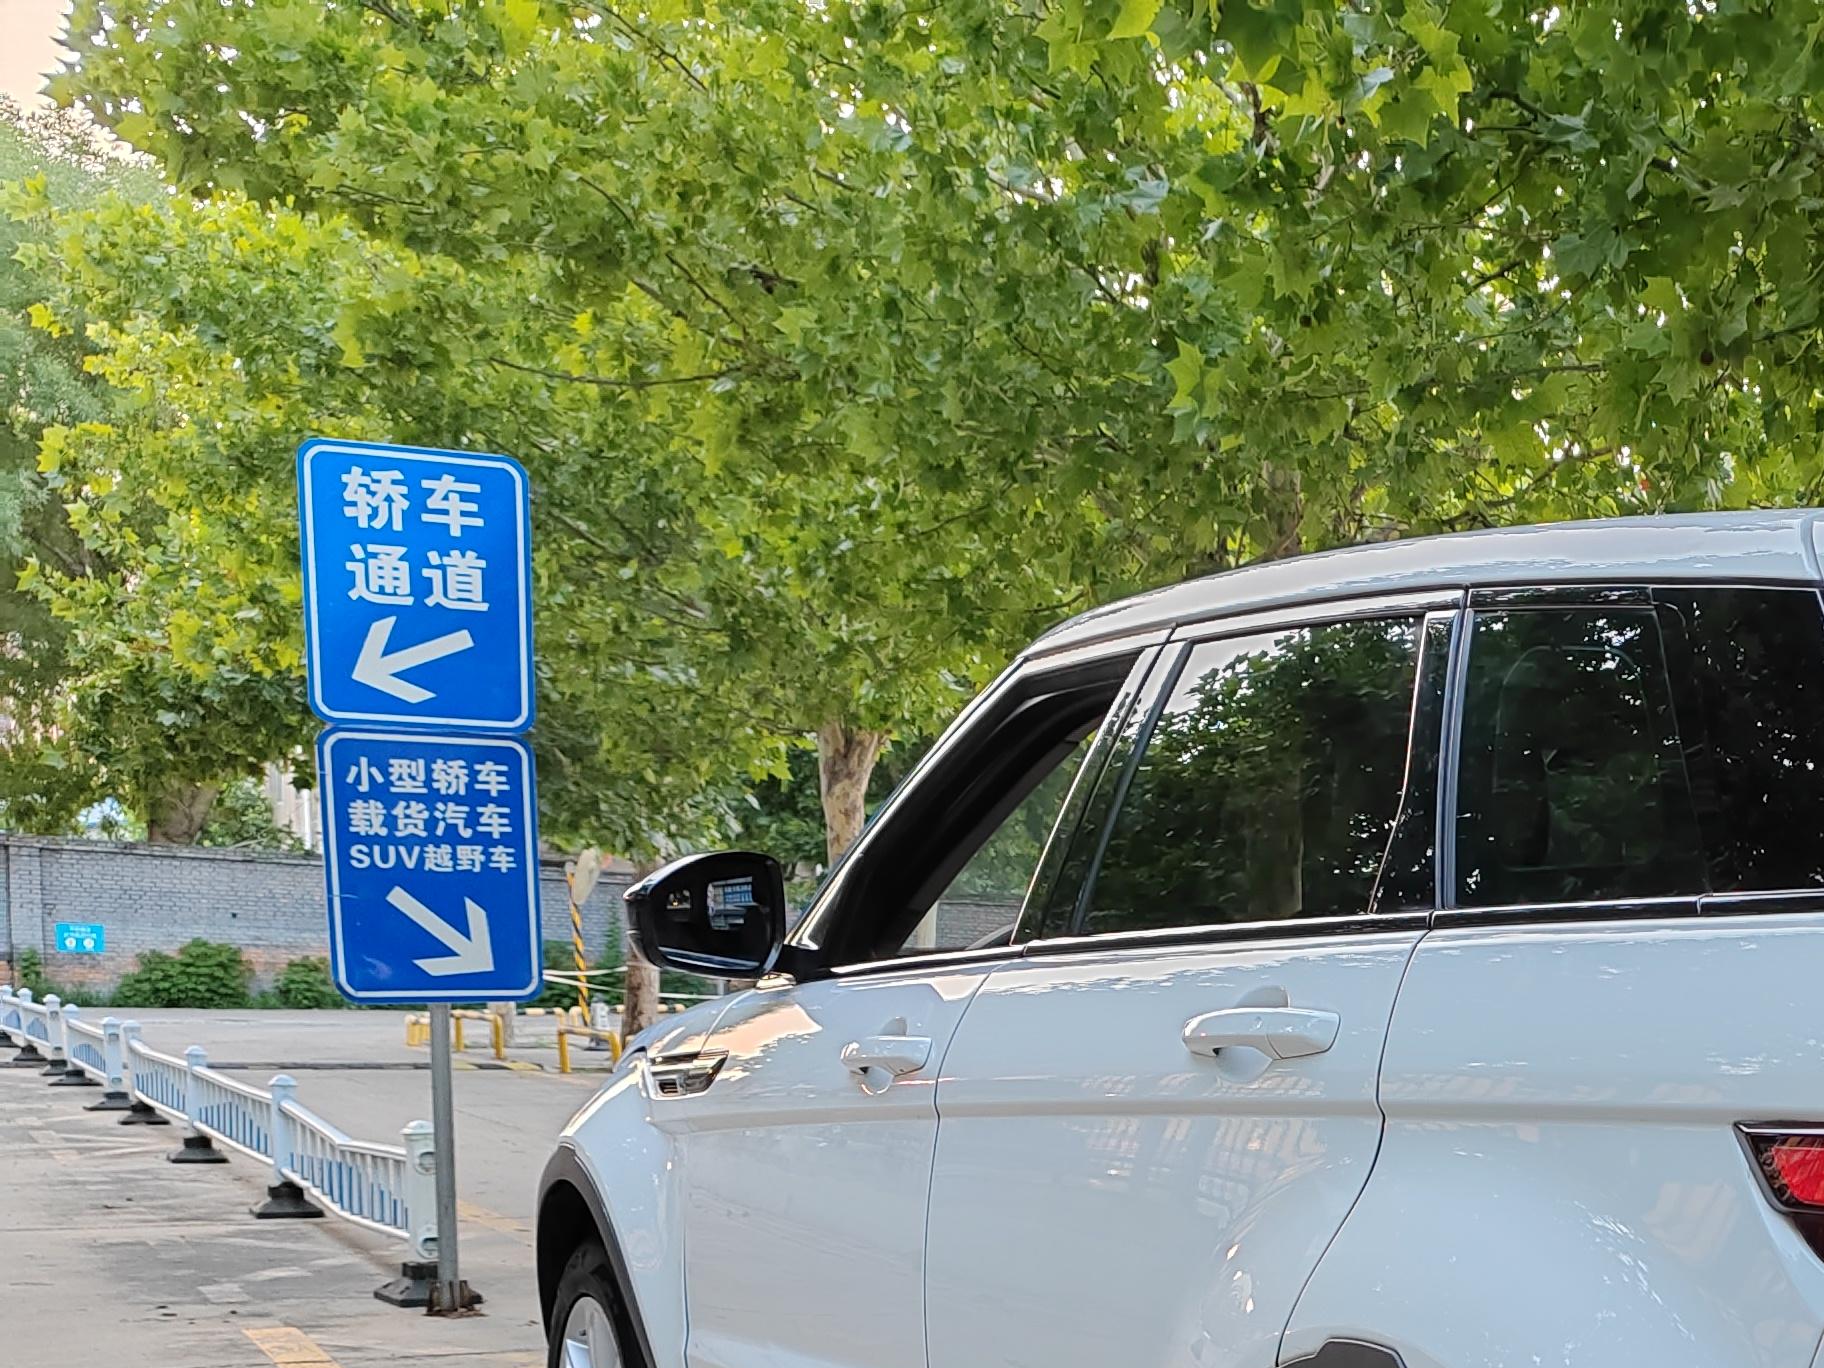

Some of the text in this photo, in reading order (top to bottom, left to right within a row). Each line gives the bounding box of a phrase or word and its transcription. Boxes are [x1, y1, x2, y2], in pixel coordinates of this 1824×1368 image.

[341, 465, 485, 538] 轿车
[345, 542, 490, 612] 通道
[346, 756, 511, 798] 小型轿车
[347, 799, 513, 839] 载货汽车
[349, 843, 518, 874] SUV越野车
